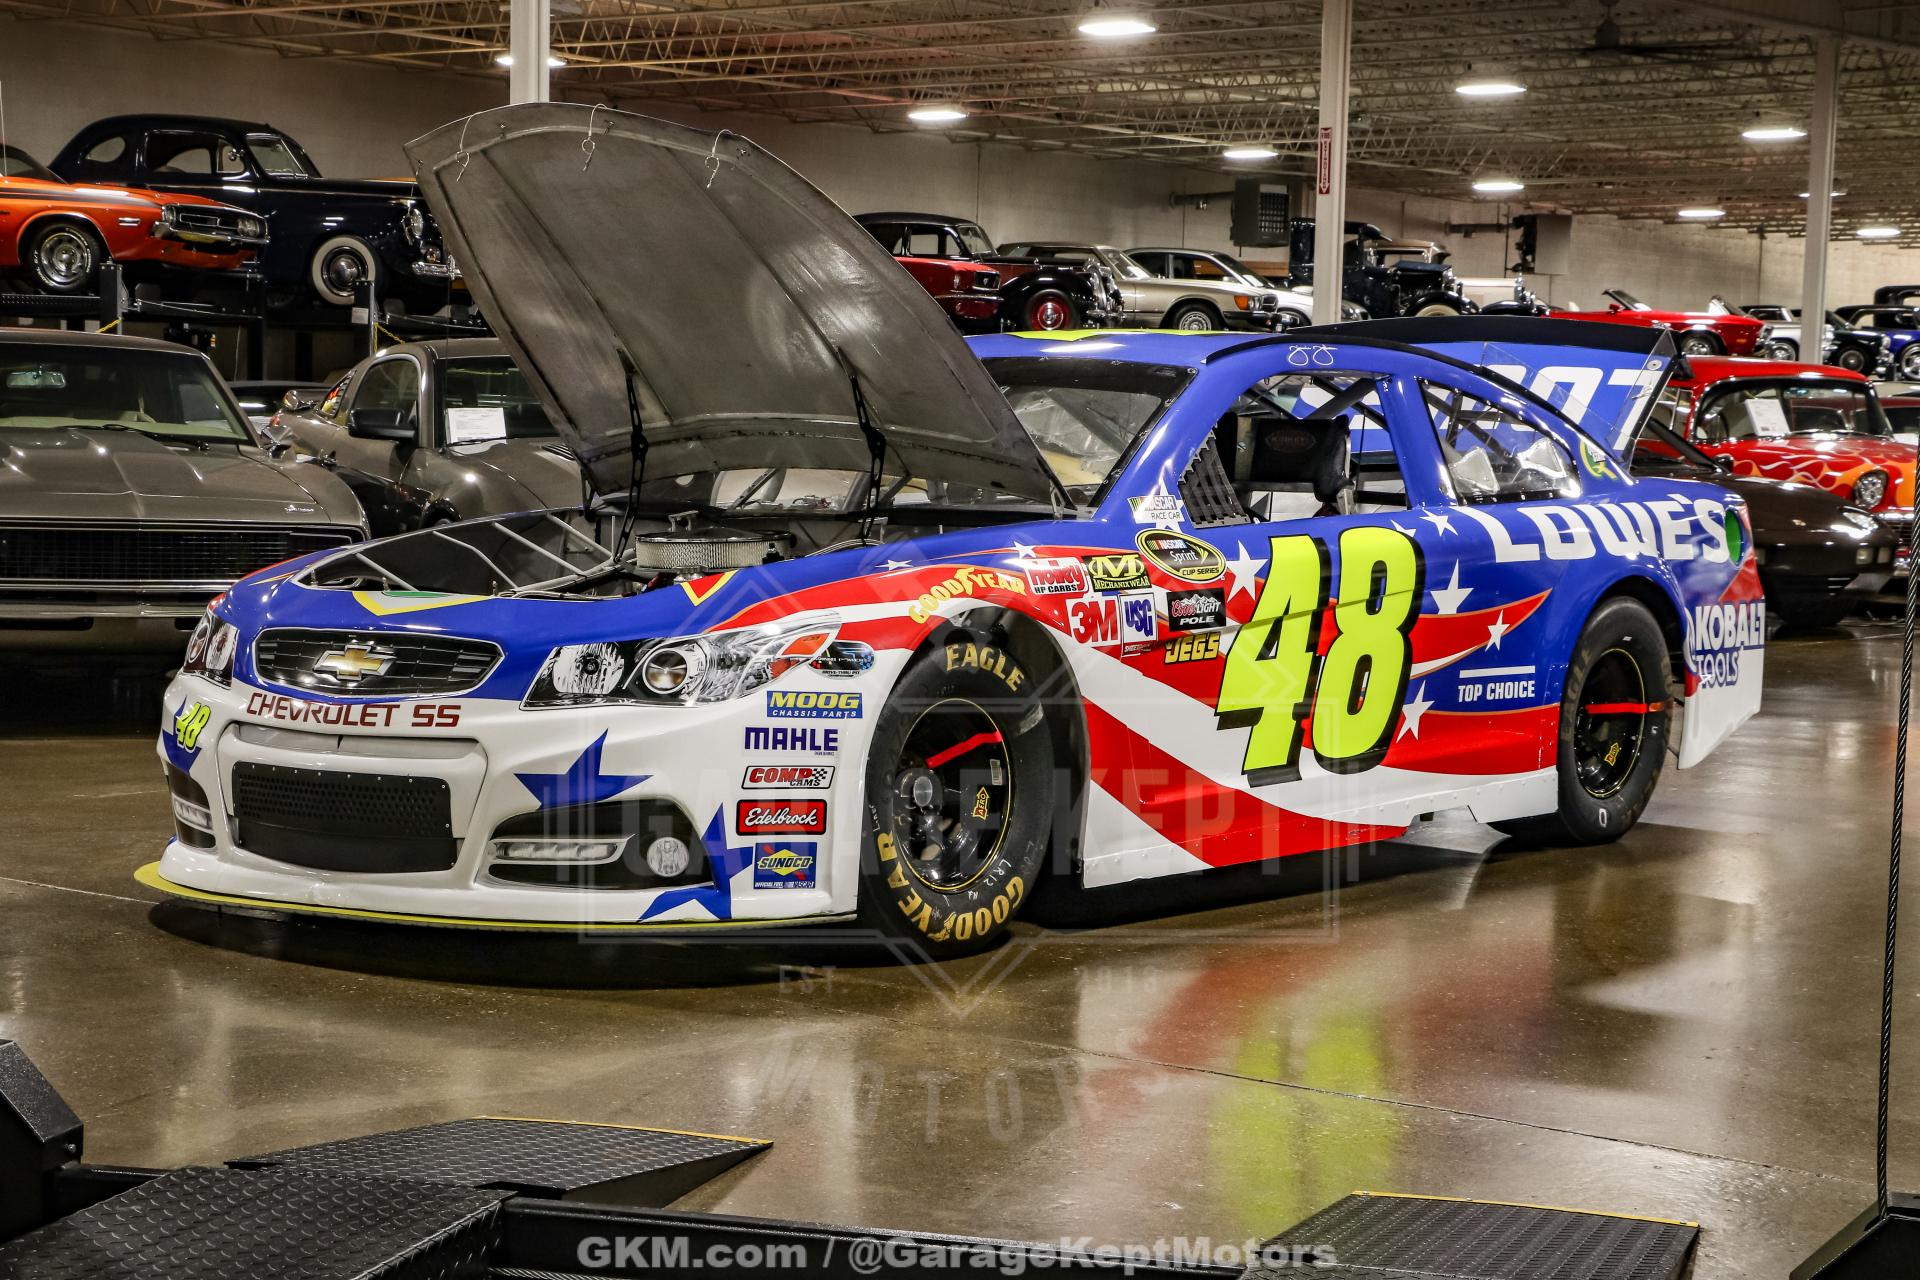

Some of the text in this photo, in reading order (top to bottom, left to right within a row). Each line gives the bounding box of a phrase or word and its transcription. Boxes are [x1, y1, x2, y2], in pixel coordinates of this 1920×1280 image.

[1151, 511, 1181, 520] RACE CAR
[1448, 494, 1730, 563] LOWE'S
[1169, 550, 1199, 564] Sprint
[1182, 567, 1220, 576] CUP SERIES
[1034, 584, 1078, 594] HP CARBS
[1093, 576, 1151, 590] MECHANIX WEAR
[909, 567, 1027, 624] GOODYEAR
[1196, 602, 1222, 614] LIGHT
[1071, 600, 1119, 644] 3M
[1123, 599, 1154, 637] USG
[1179, 615, 1215, 626] POLE
[1695, 602, 1766, 651] KOBALT
[1216, 526, 1424, 782] 48
[946, 642, 1025, 692] EAGLE
[1692, 651, 1740, 687] TOOLS
[769, 692, 861, 709] MOOG
[1457, 680, 1537, 702] TOP CHOICE
[246, 692, 462, 727] CHEVROLET SS
[772, 709, 858, 719] CHASSIS PARTS
[176, 701, 211, 751] 48
[744, 726, 839, 751] MAHLE
[748, 767, 813, 783] COMP
[789, 779, 821, 787] CAMS
[744, 807, 818, 826] Edelbrock
[758, 856, 812, 869] SUNOCO
